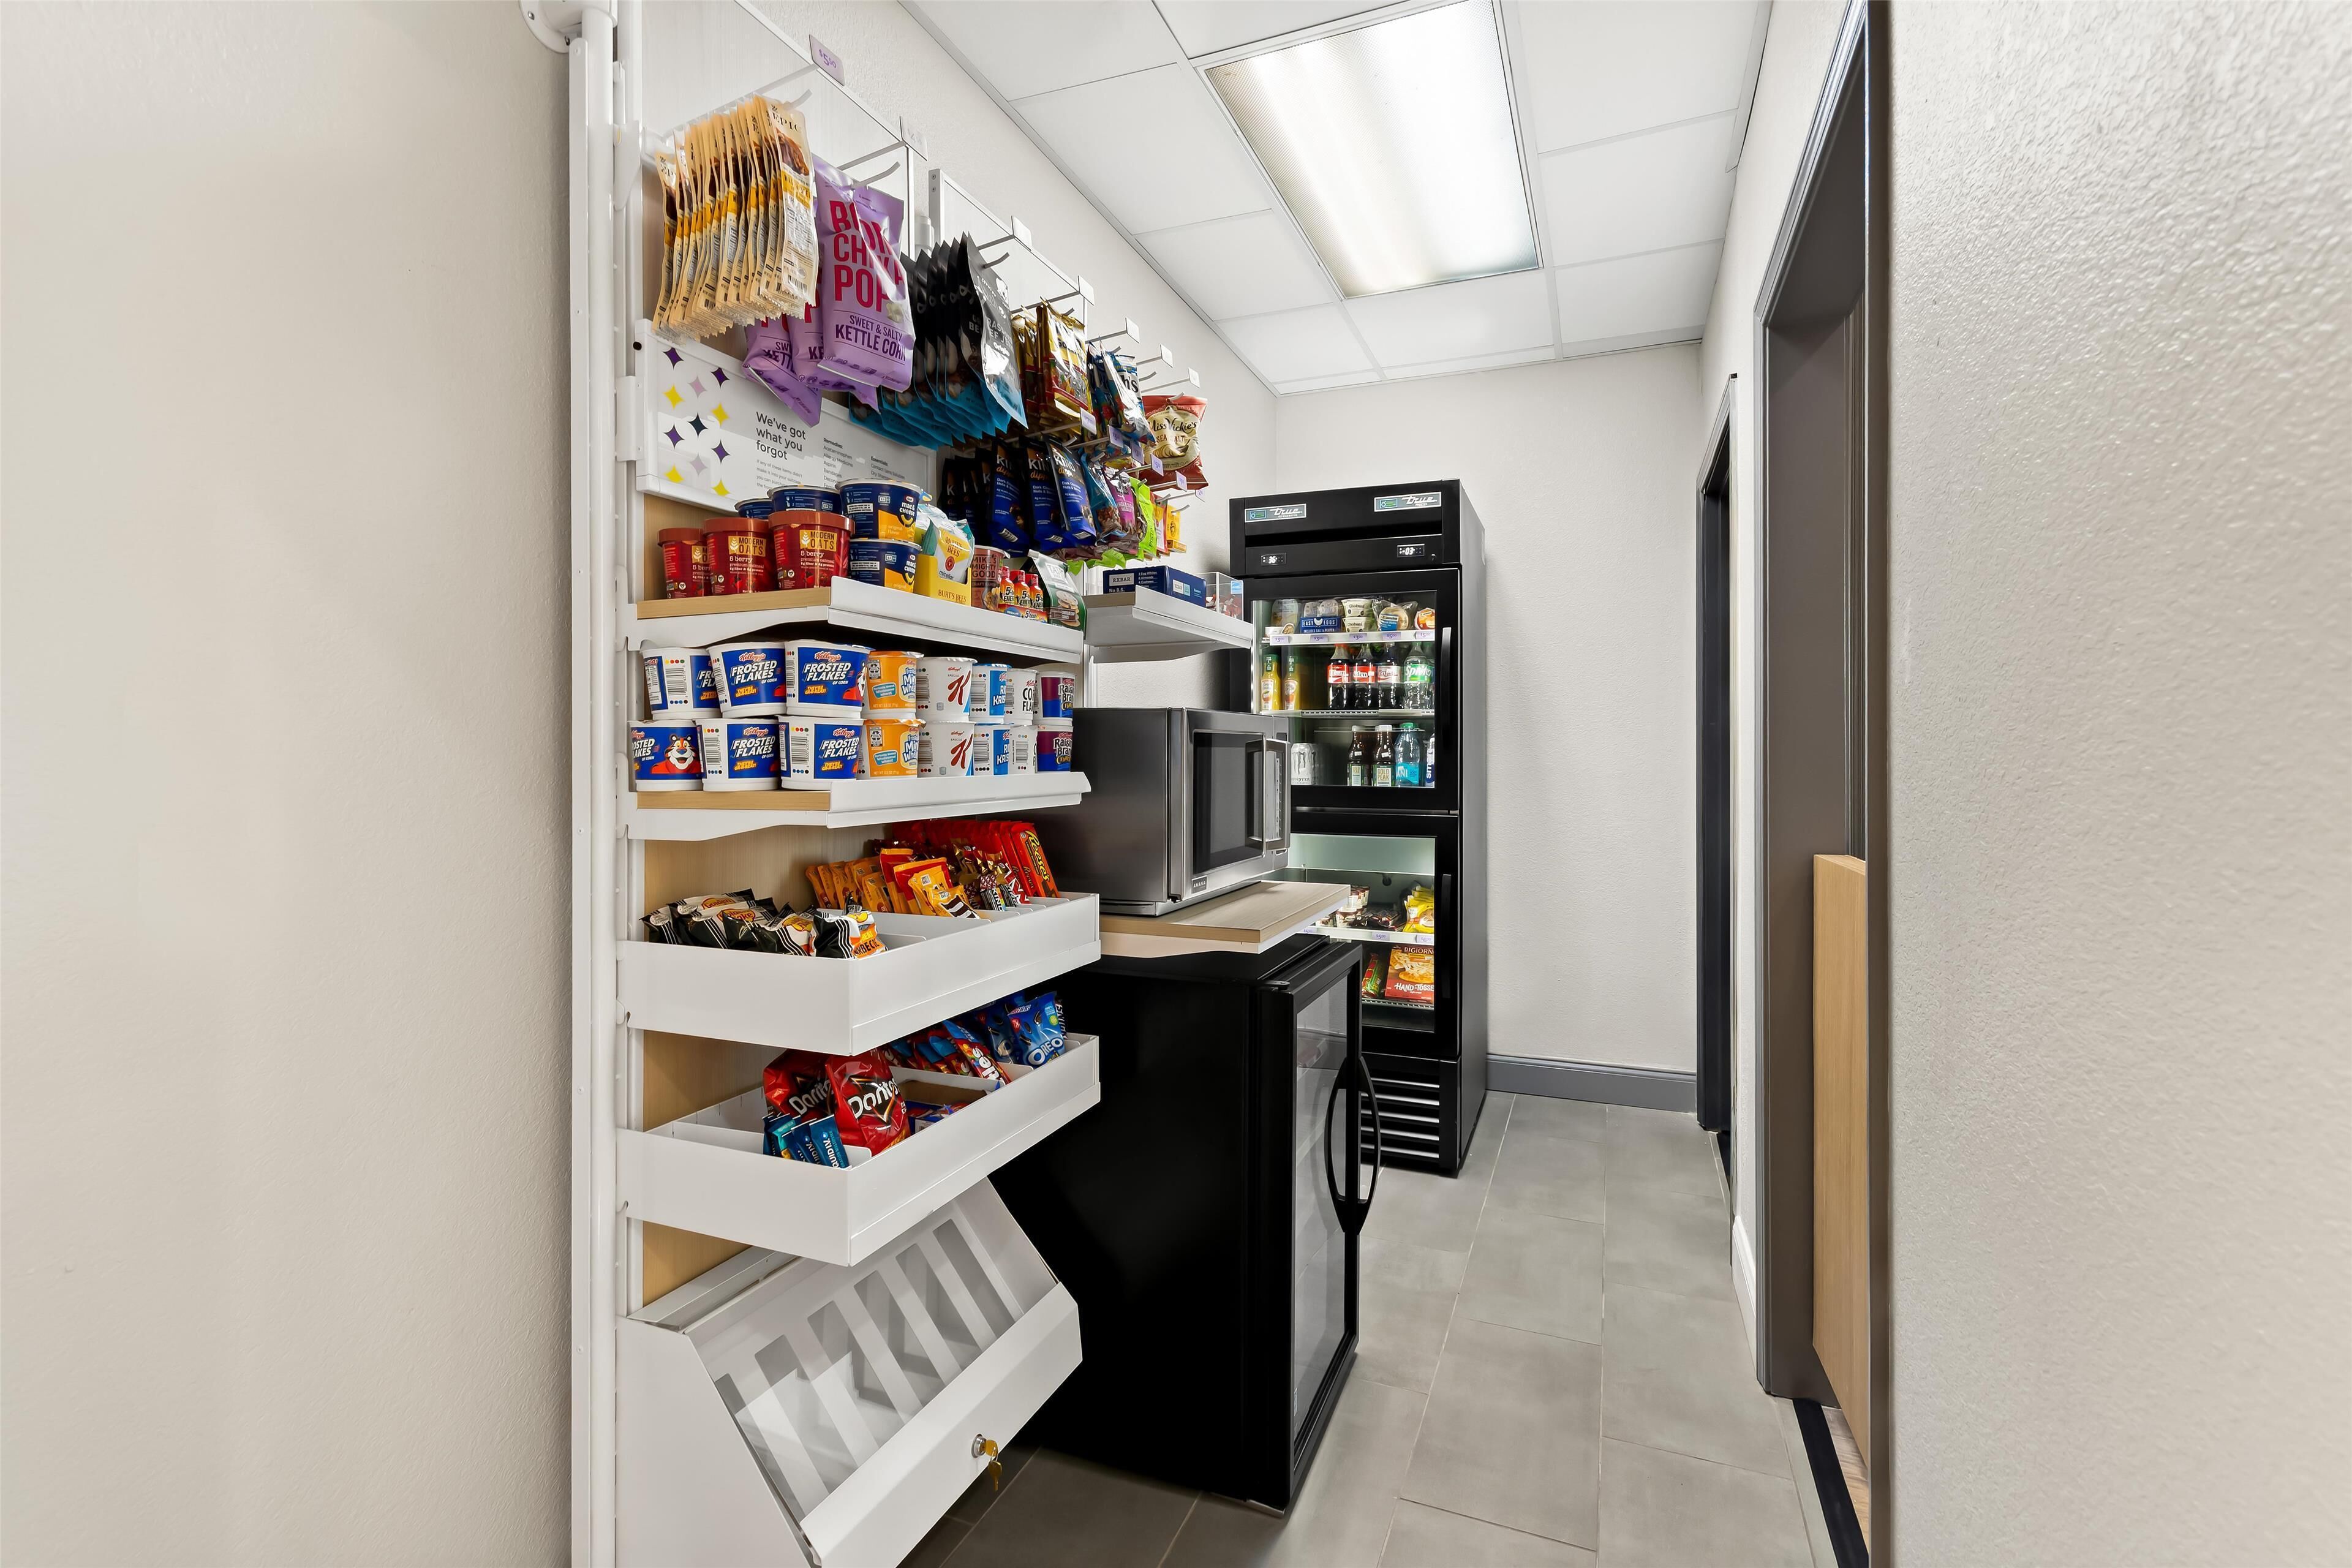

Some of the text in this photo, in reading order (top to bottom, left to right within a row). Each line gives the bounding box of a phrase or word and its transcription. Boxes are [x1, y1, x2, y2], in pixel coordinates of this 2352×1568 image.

[850, 315, 902, 341] SWEET & SALTY
[835, 324, 906, 361] KETTLE CORN
[756, 412, 806, 440] We've got
[1165, 418, 1197, 434] Vickie's
[756, 428, 802, 452] what you
[1156, 434, 1167, 443] SEA
[756, 440, 788, 460] forgot
[739, 537, 764, 546] MODERN
[810, 531, 834, 540] MODERN
[810, 538, 834, 550] OATS
[739, 545, 763, 556] OATS
[947, 545, 959, 557] BEES
[973, 555, 997, 564] MIKE'S
[938, 589, 967, 602] BURT'S BEES
[739, 652, 766, 662] Kellogg's
[815, 651, 842, 662] Kellogg's
[732, 660, 777, 677] FROSTED
[804, 662, 851, 673] FROSTED
[735, 669, 774, 684] FLAKES
[806, 671, 846, 682] FLAKES
[948, 670, 971, 706] K
[744, 726, 768, 737] Kellogg's
[833, 728, 854, 737] Kellogg's
[734, 736, 775, 749] FROSTED
[822, 737, 859, 749] FROSTED
[736, 745, 773, 758] FLAKES
[824, 747, 857, 758] FLAKES
[951, 734, 973, 769] K
[1025, 831, 1050, 882] Reese's
[1029, 1038, 1063, 1065] OREO
